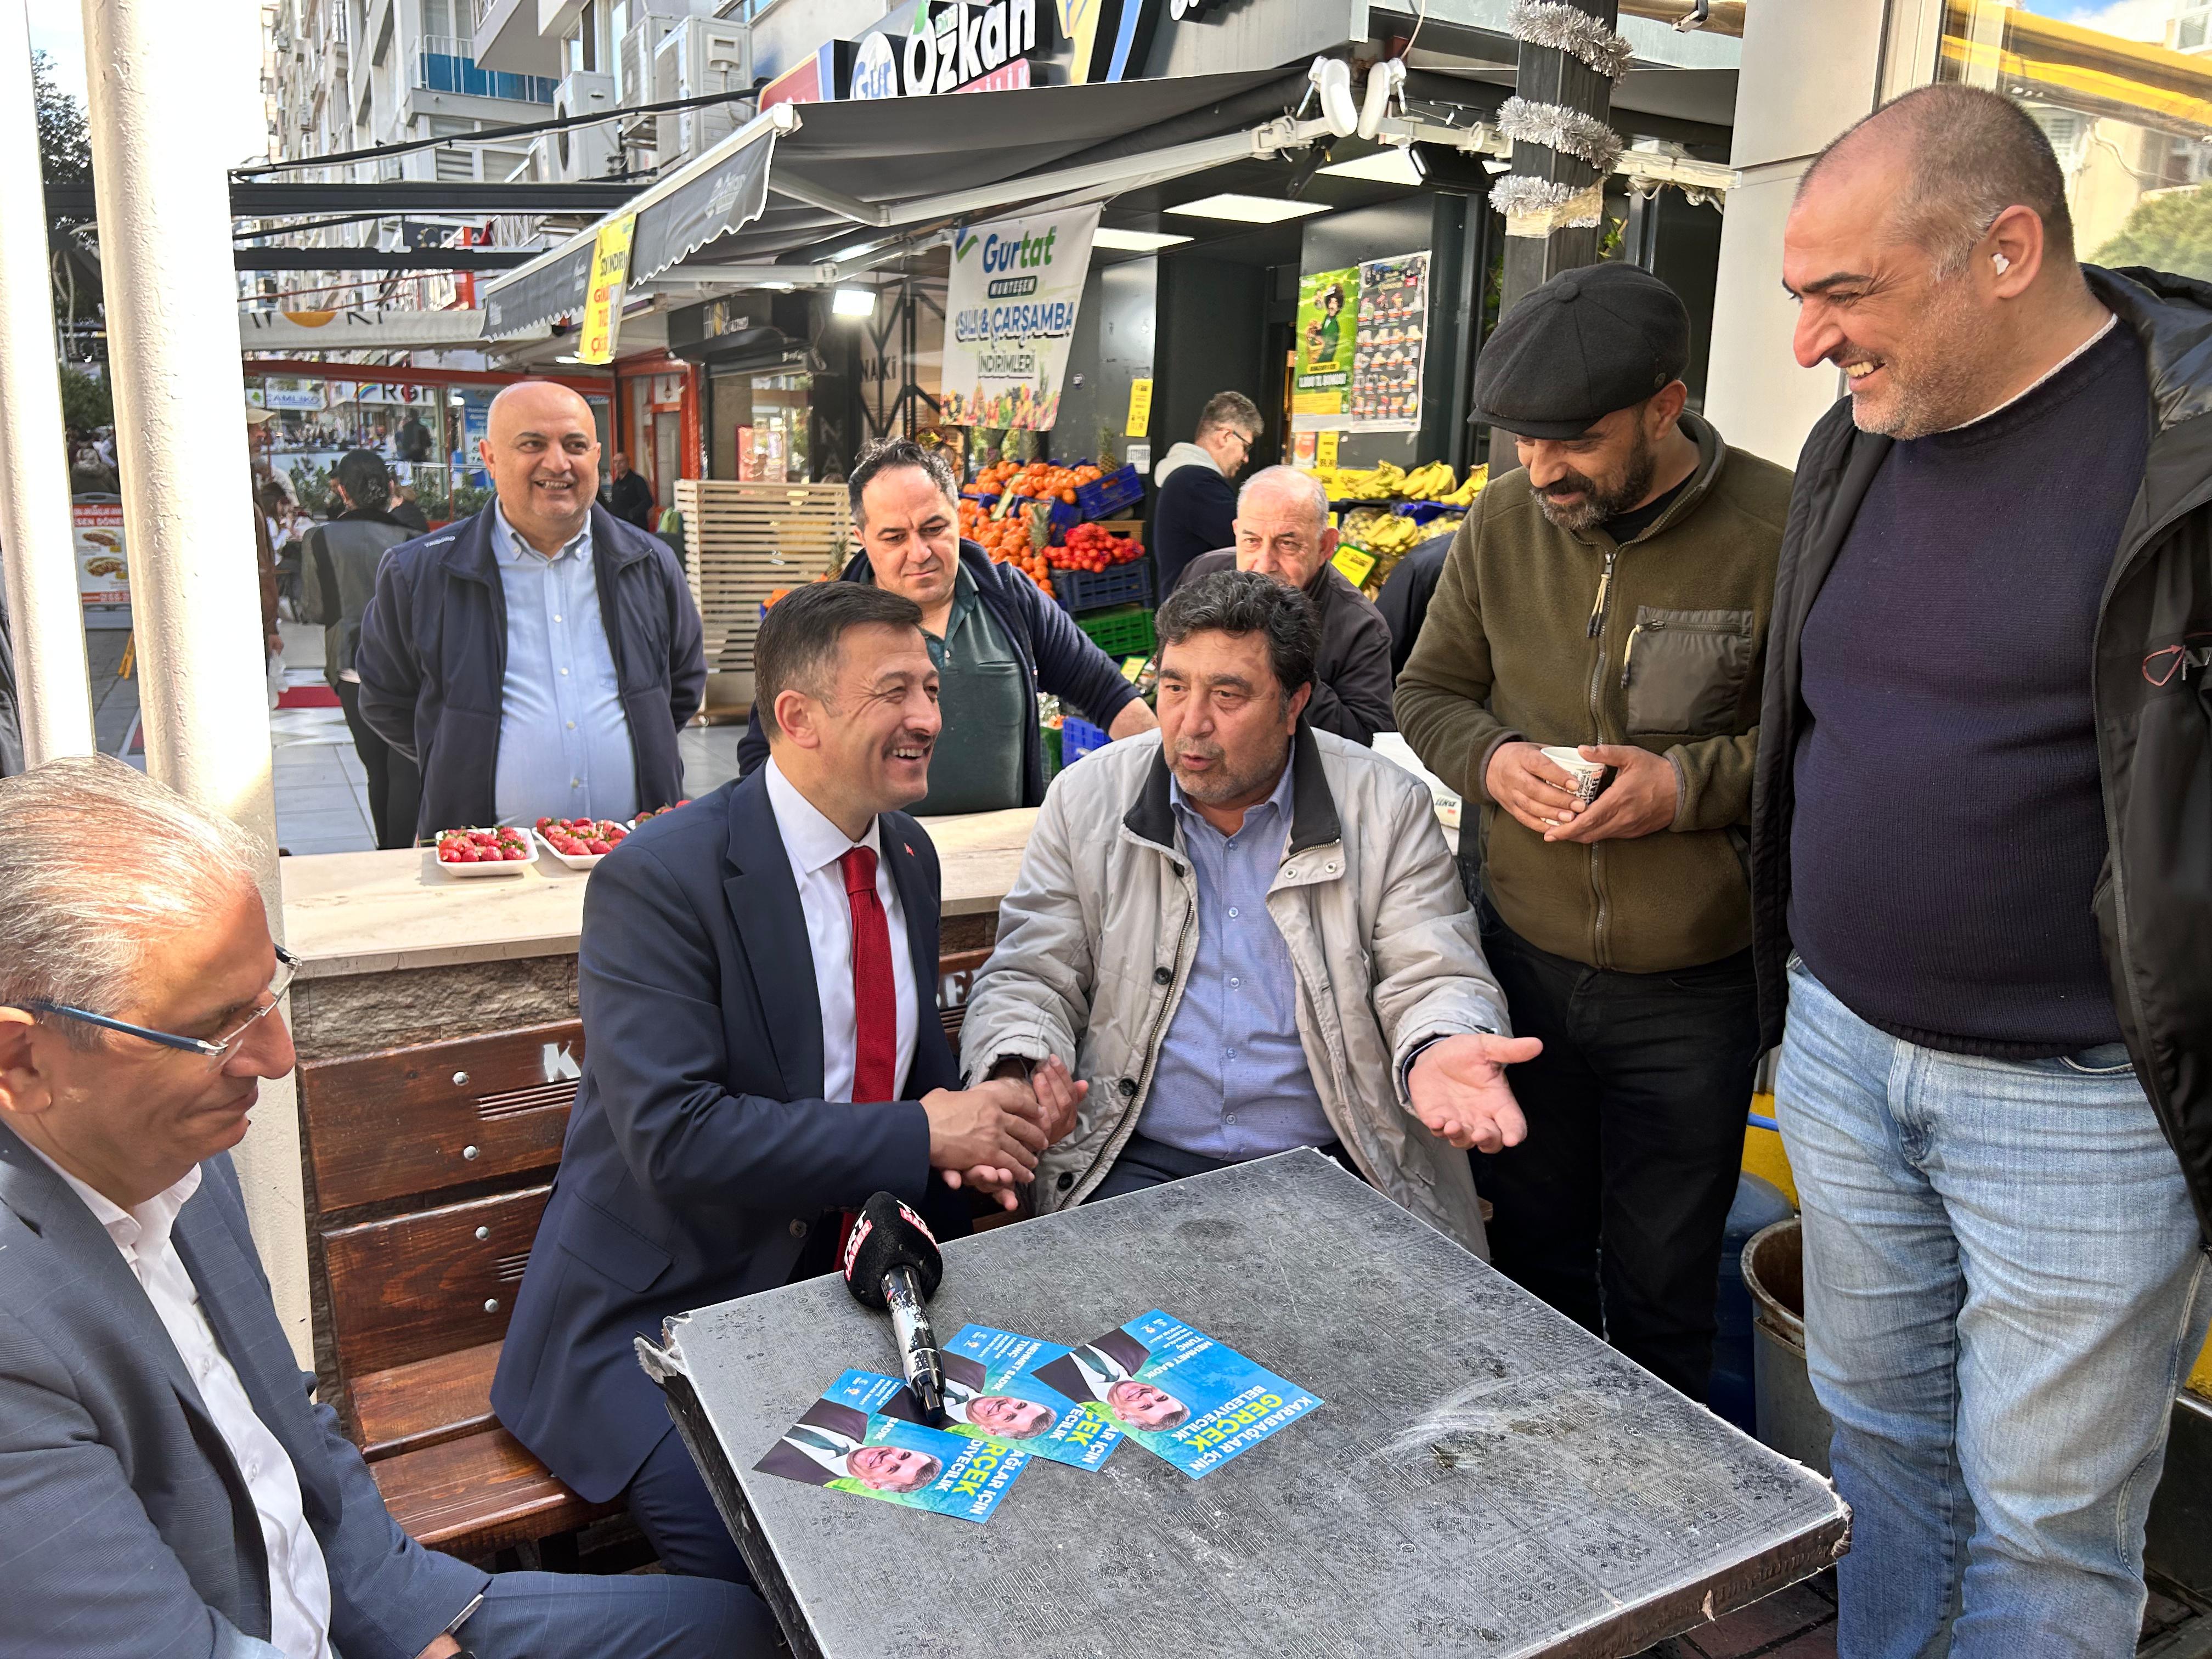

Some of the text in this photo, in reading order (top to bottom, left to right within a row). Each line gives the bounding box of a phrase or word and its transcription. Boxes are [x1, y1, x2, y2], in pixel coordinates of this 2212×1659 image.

[980, 307, 990, 334] &
[991, 301, 1074, 346] ÇARŞAMBA
[1007, 1339, 1030, 1358] TUNÇ
[1143, 1340, 1214, 1379] MEHMET SADIK
[1176, 1335, 1204, 1352] TUNÇ
[991, 1342, 1041, 1392] MEHMET SADIK
[1183, 1391, 1283, 1452] GERÇEK
[1218, 1395, 1313, 1454] KARABAĞLAR
